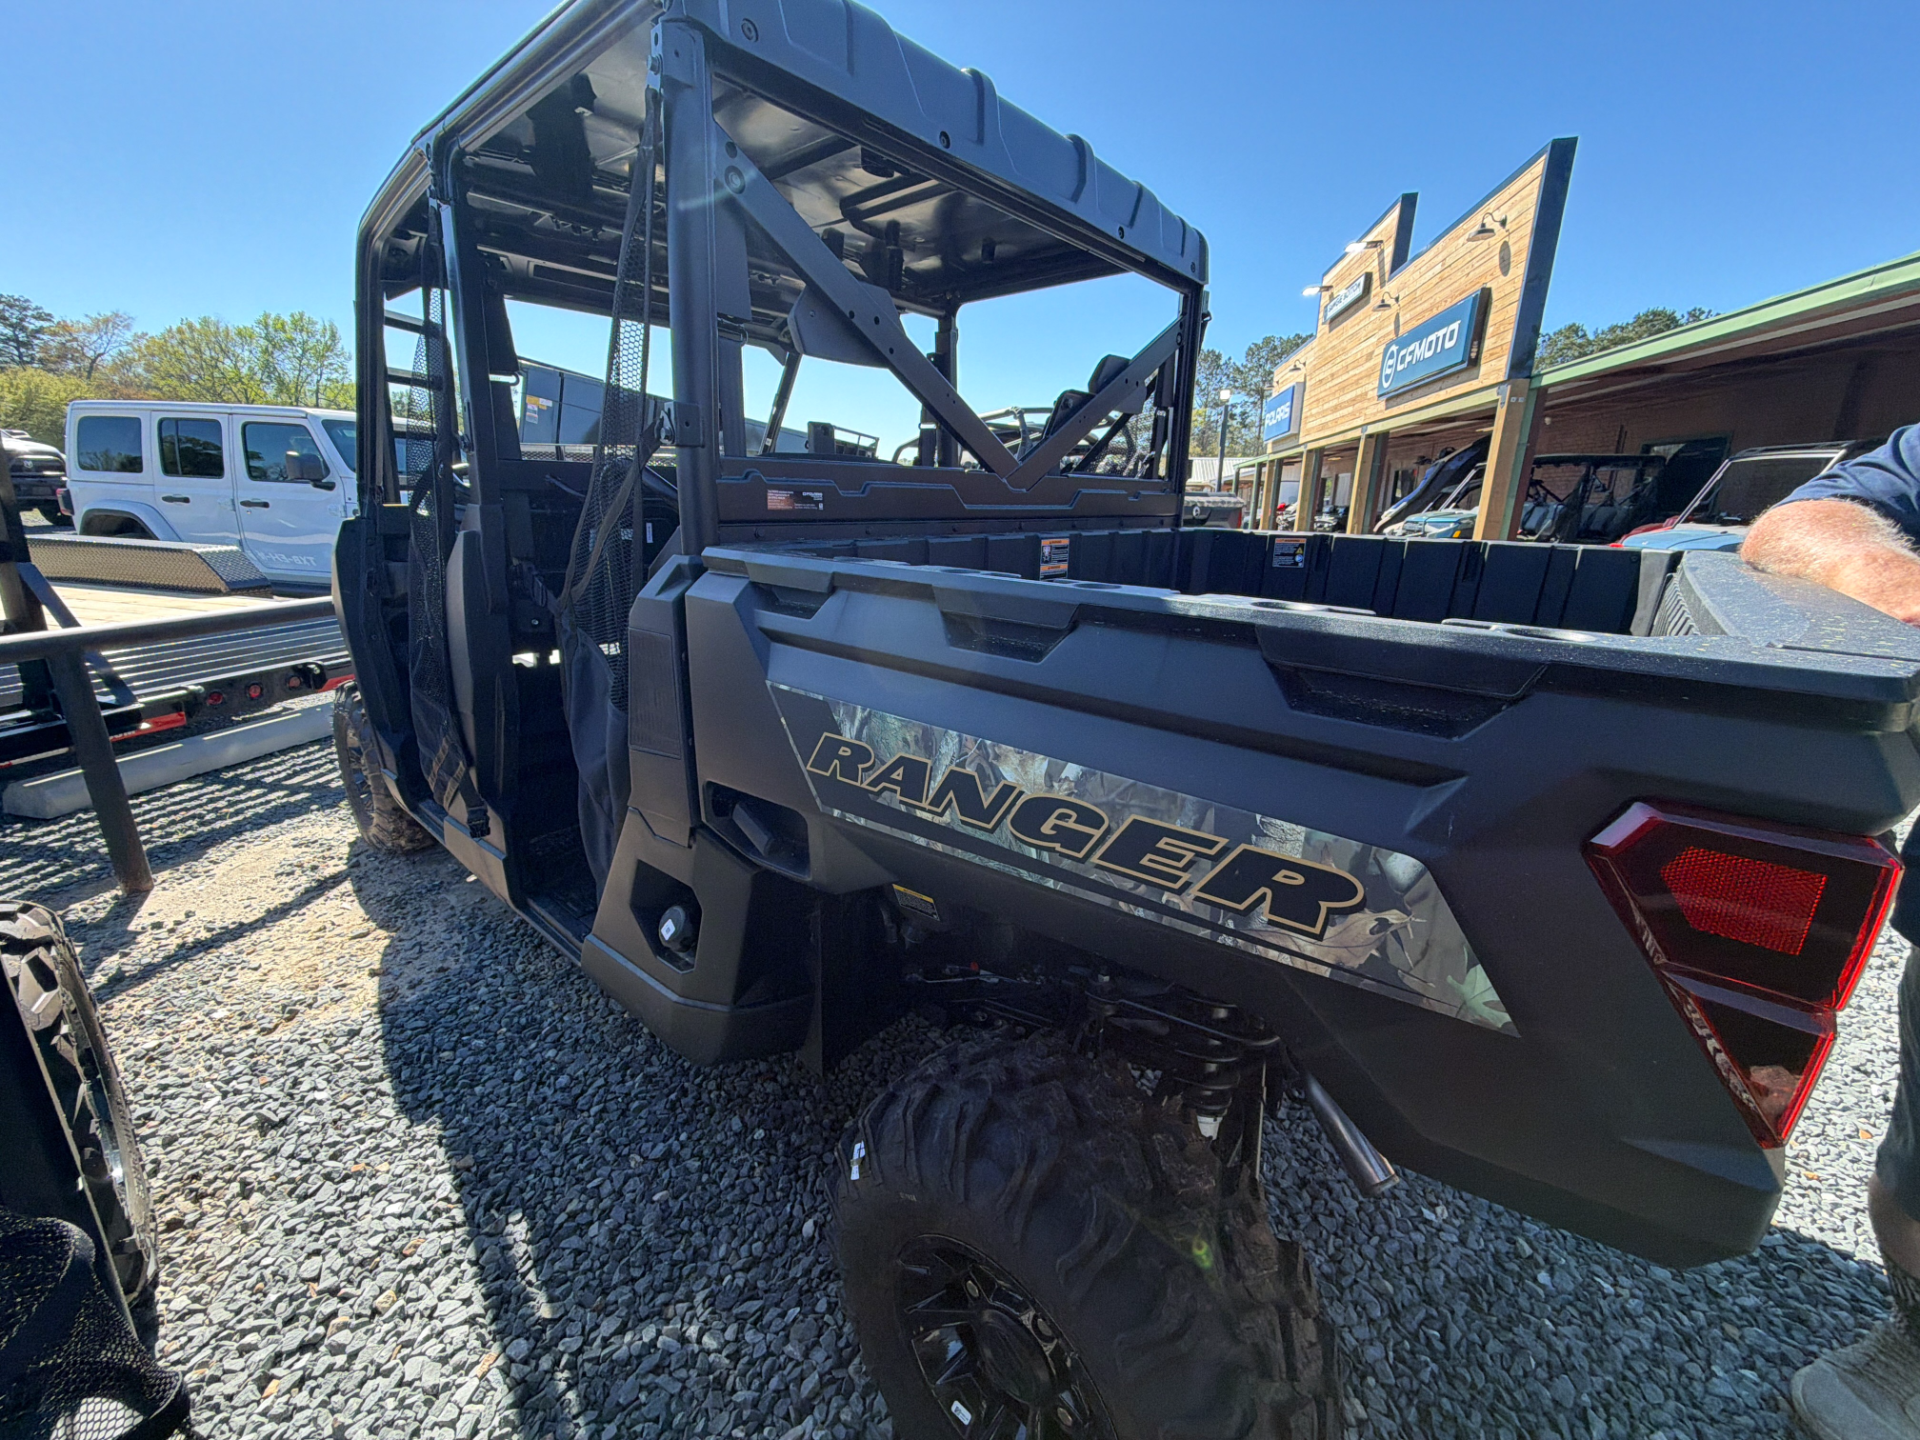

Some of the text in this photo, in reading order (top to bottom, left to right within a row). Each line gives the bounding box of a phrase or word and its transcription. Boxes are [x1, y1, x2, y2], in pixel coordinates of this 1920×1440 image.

[1396, 319, 1462, 372] CFMOTO
[1264, 401, 1291, 429] POLARIS
[805, 731, 1367, 938] RANGER
